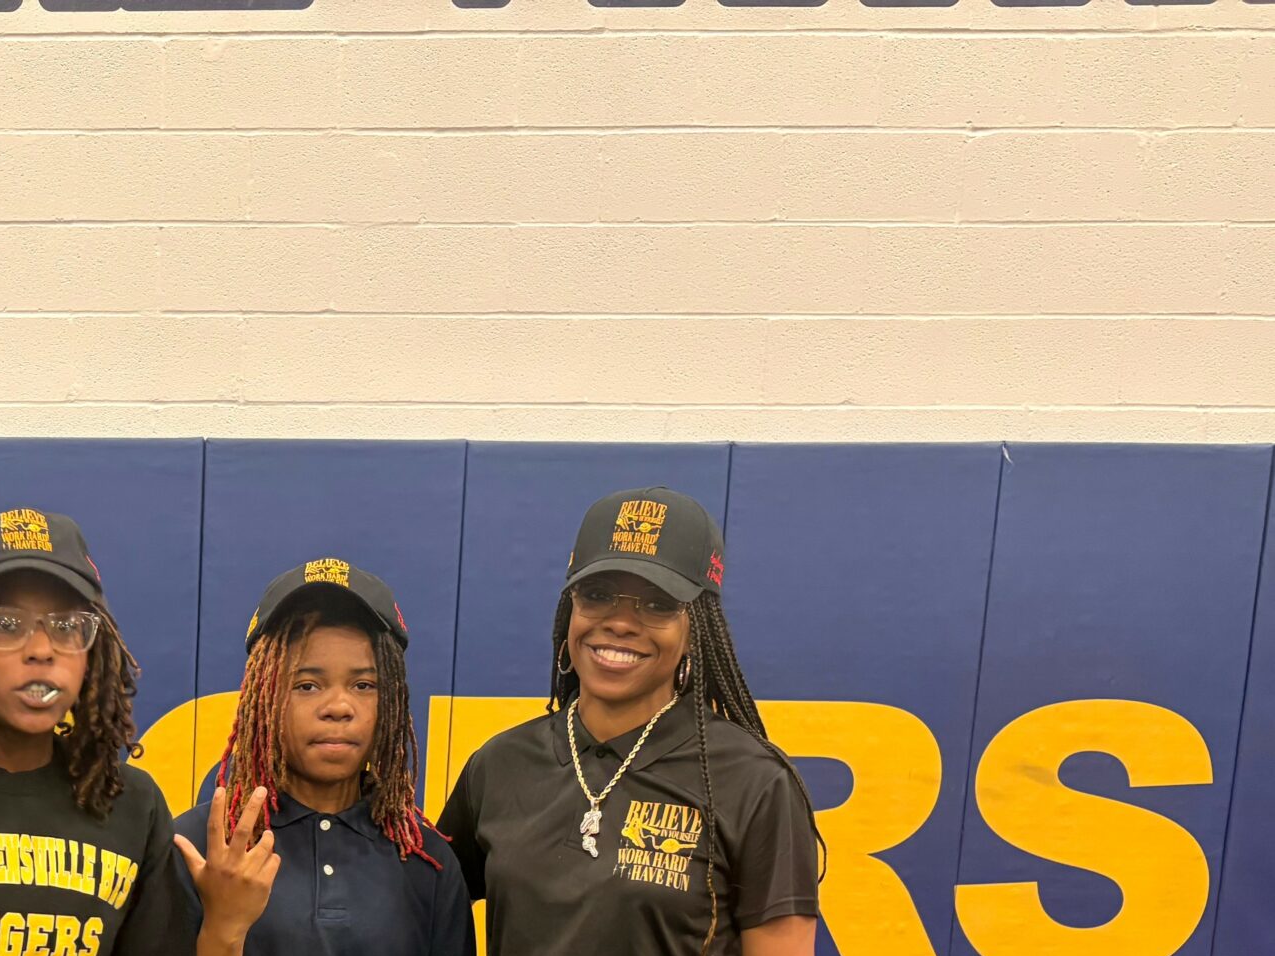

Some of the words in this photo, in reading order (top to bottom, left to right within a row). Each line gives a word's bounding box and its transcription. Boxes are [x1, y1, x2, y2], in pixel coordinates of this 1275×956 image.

[617, 500, 667, 519] BELIEVE
[0, 509, 47, 529] BELIEVE
[1, 531, 25, 543] WORK
[26, 531, 49, 543] HARD
[634, 532, 659, 545] HARD
[15, 540, 37, 550] HAVE
[37, 541, 53, 552] FUN
[620, 542, 642, 553] HAVE
[641, 544, 657, 556] FUN
[625, 800, 702, 834] BELIEVE
[668, 830, 700, 843] YOURSELF
[618, 848, 652, 866] WORK
[652, 852, 688, 873] HARD
[631, 865, 665, 885] HAVE
[666, 871, 690, 892] FUN
